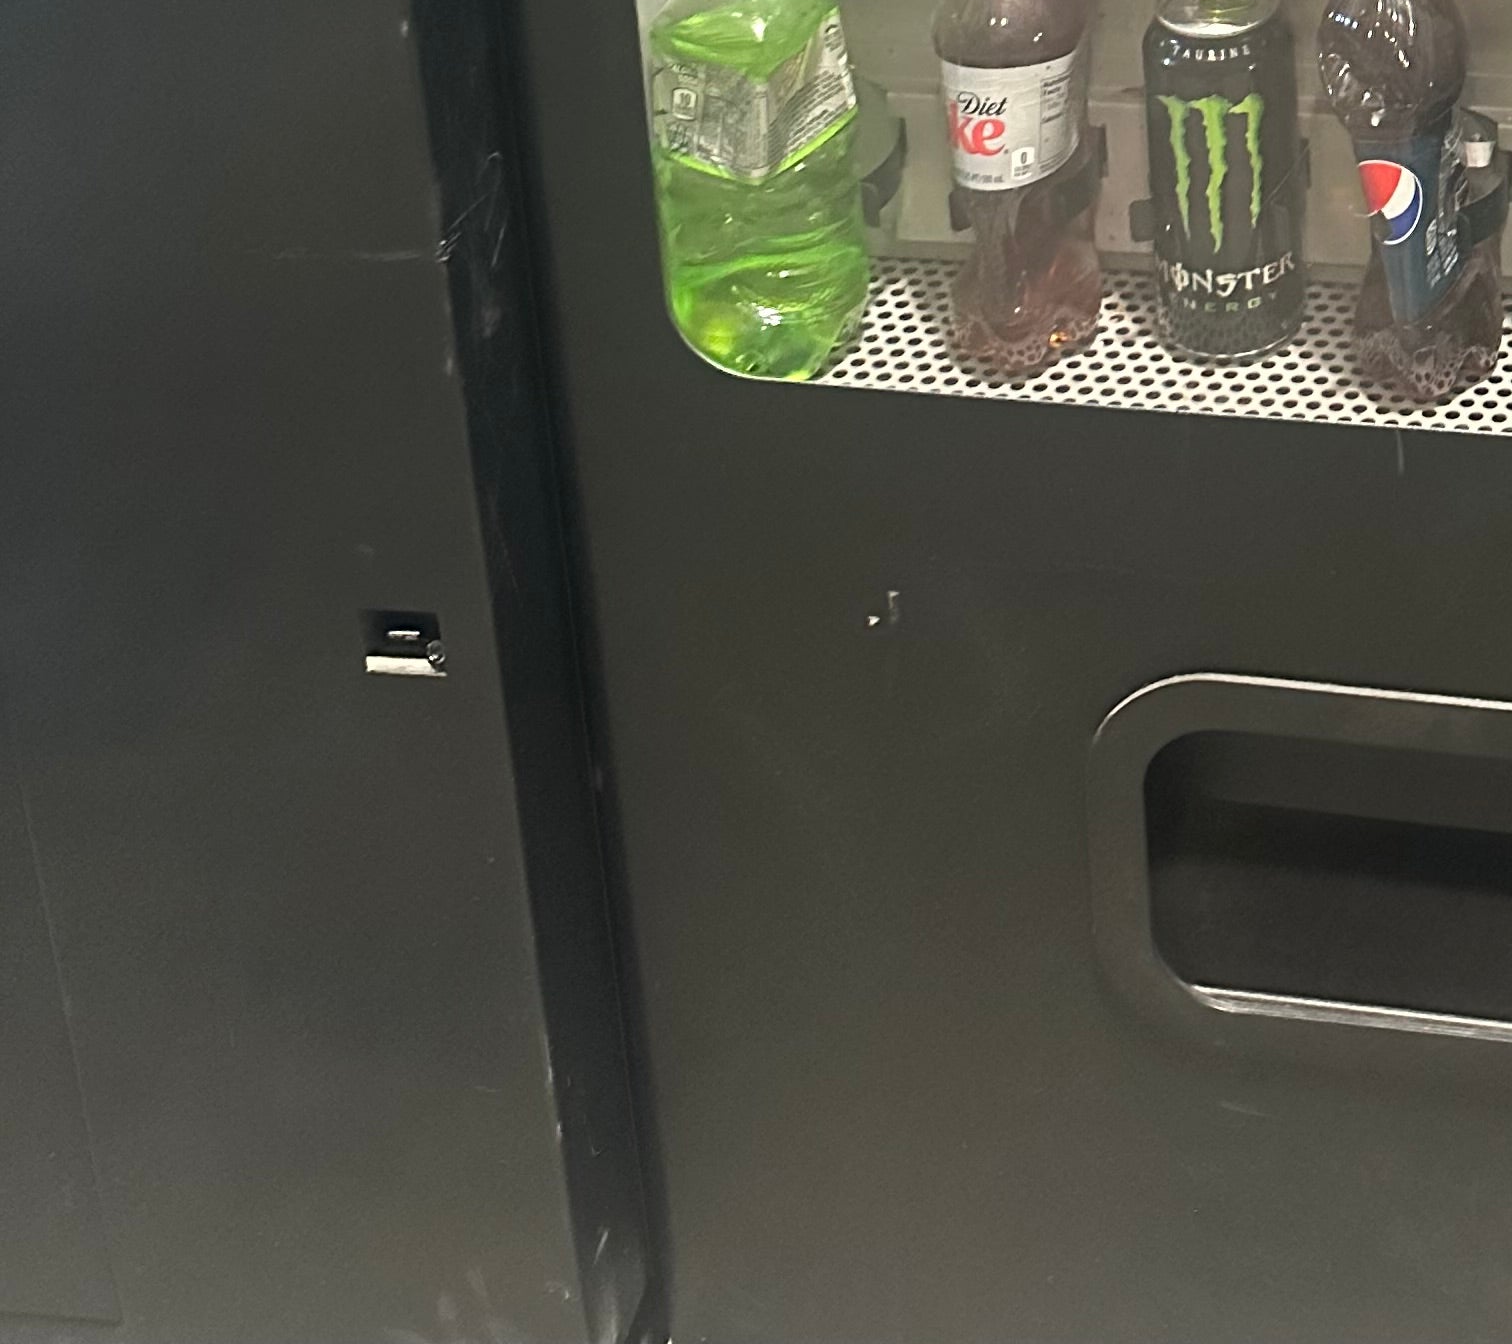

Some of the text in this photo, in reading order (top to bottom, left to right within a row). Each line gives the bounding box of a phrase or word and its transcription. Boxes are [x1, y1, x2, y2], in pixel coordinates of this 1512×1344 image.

[957, 91, 1008, 116] Diet
[949, 98, 1006, 156] ke
[1183, 292, 1277, 313] NERGY
